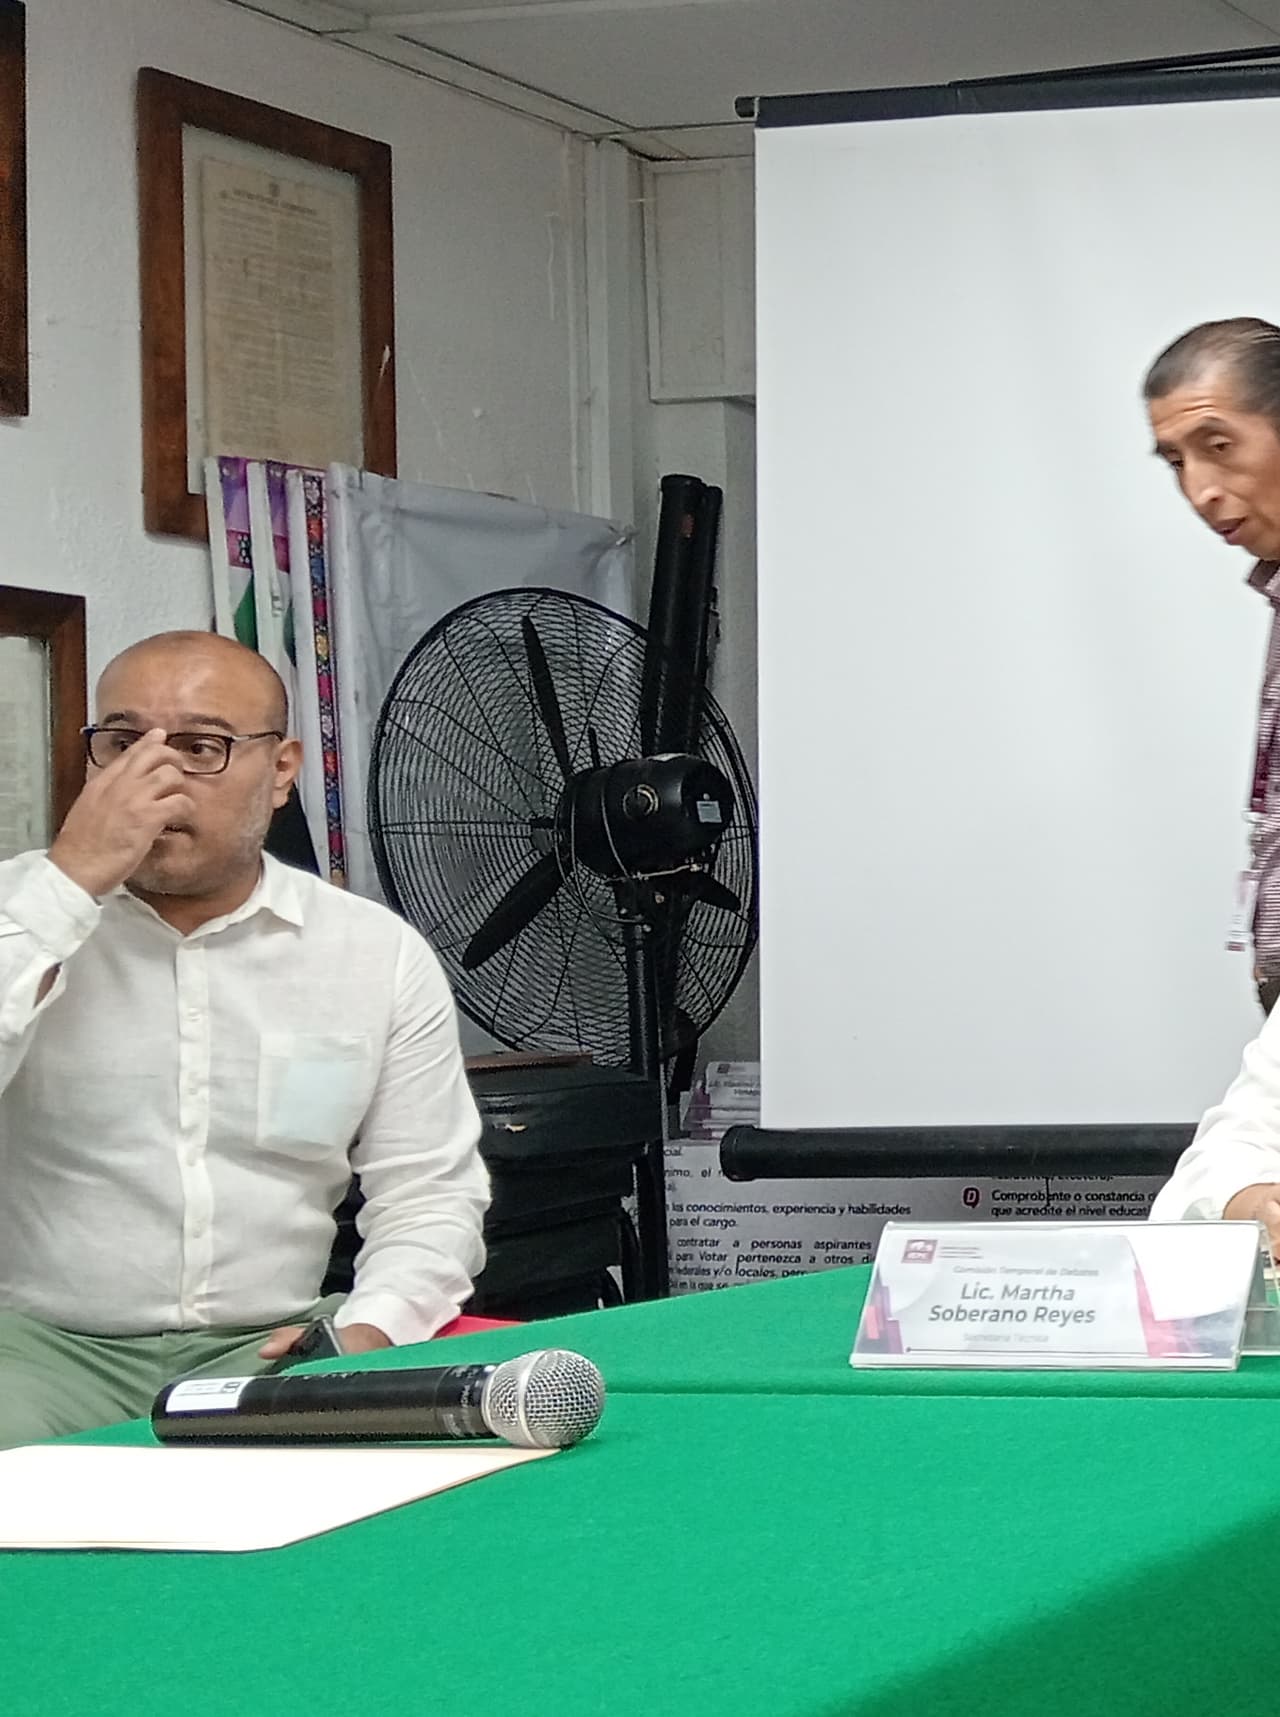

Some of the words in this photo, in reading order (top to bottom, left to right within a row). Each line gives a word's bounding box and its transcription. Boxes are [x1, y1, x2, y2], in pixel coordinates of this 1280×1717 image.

[1085, 1192, 1144, 1201] constancia
[773, 1203, 835, 1216] experiencia
[991, 1207, 1012, 1217] que
[1066, 1205, 1076, 1216] el
[1080, 1205, 1106, 1216] nivel
[751, 1240, 802, 1250] personas
[814, 1240, 872, 1252] aspirantes
[960, 1282, 994, 1300] Lic.
[1001, 1283, 1075, 1301] Martha
[928, 1304, 1028, 1323] Soberano
[1034, 1306, 1096, 1328] Reyes
